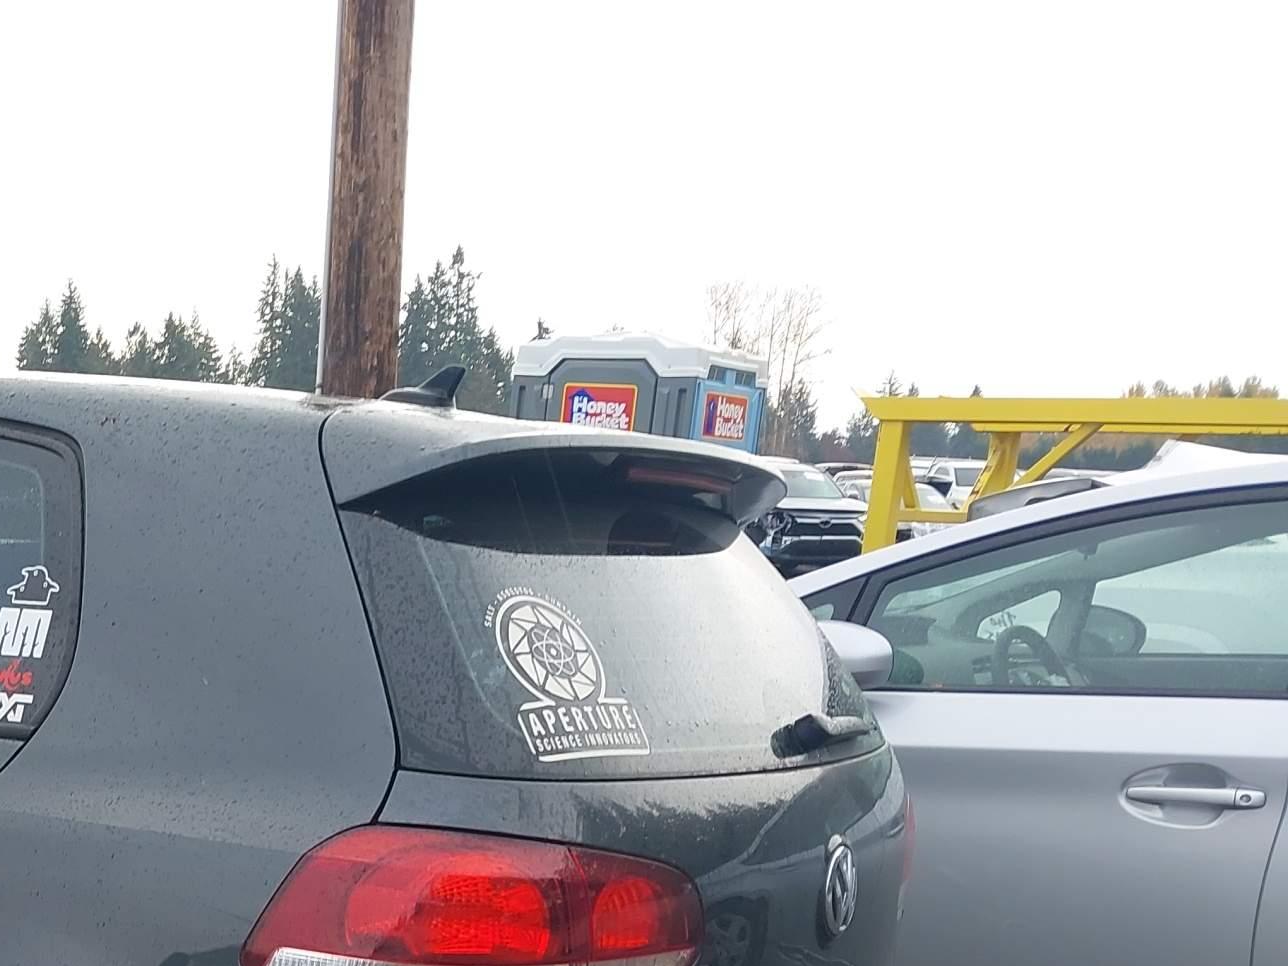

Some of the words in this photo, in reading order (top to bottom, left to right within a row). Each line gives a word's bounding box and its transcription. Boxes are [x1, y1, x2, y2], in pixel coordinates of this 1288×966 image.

[573, 395, 626, 416] Honey
[717, 396, 744, 420] Honey
[572, 412, 630, 429] Bucket
[714, 419, 744, 438] Bucket
[528, 704, 636, 736] APERTURE
[536, 734, 582, 752] SCIENCE
[584, 732, 641, 746] INNOVATORS
